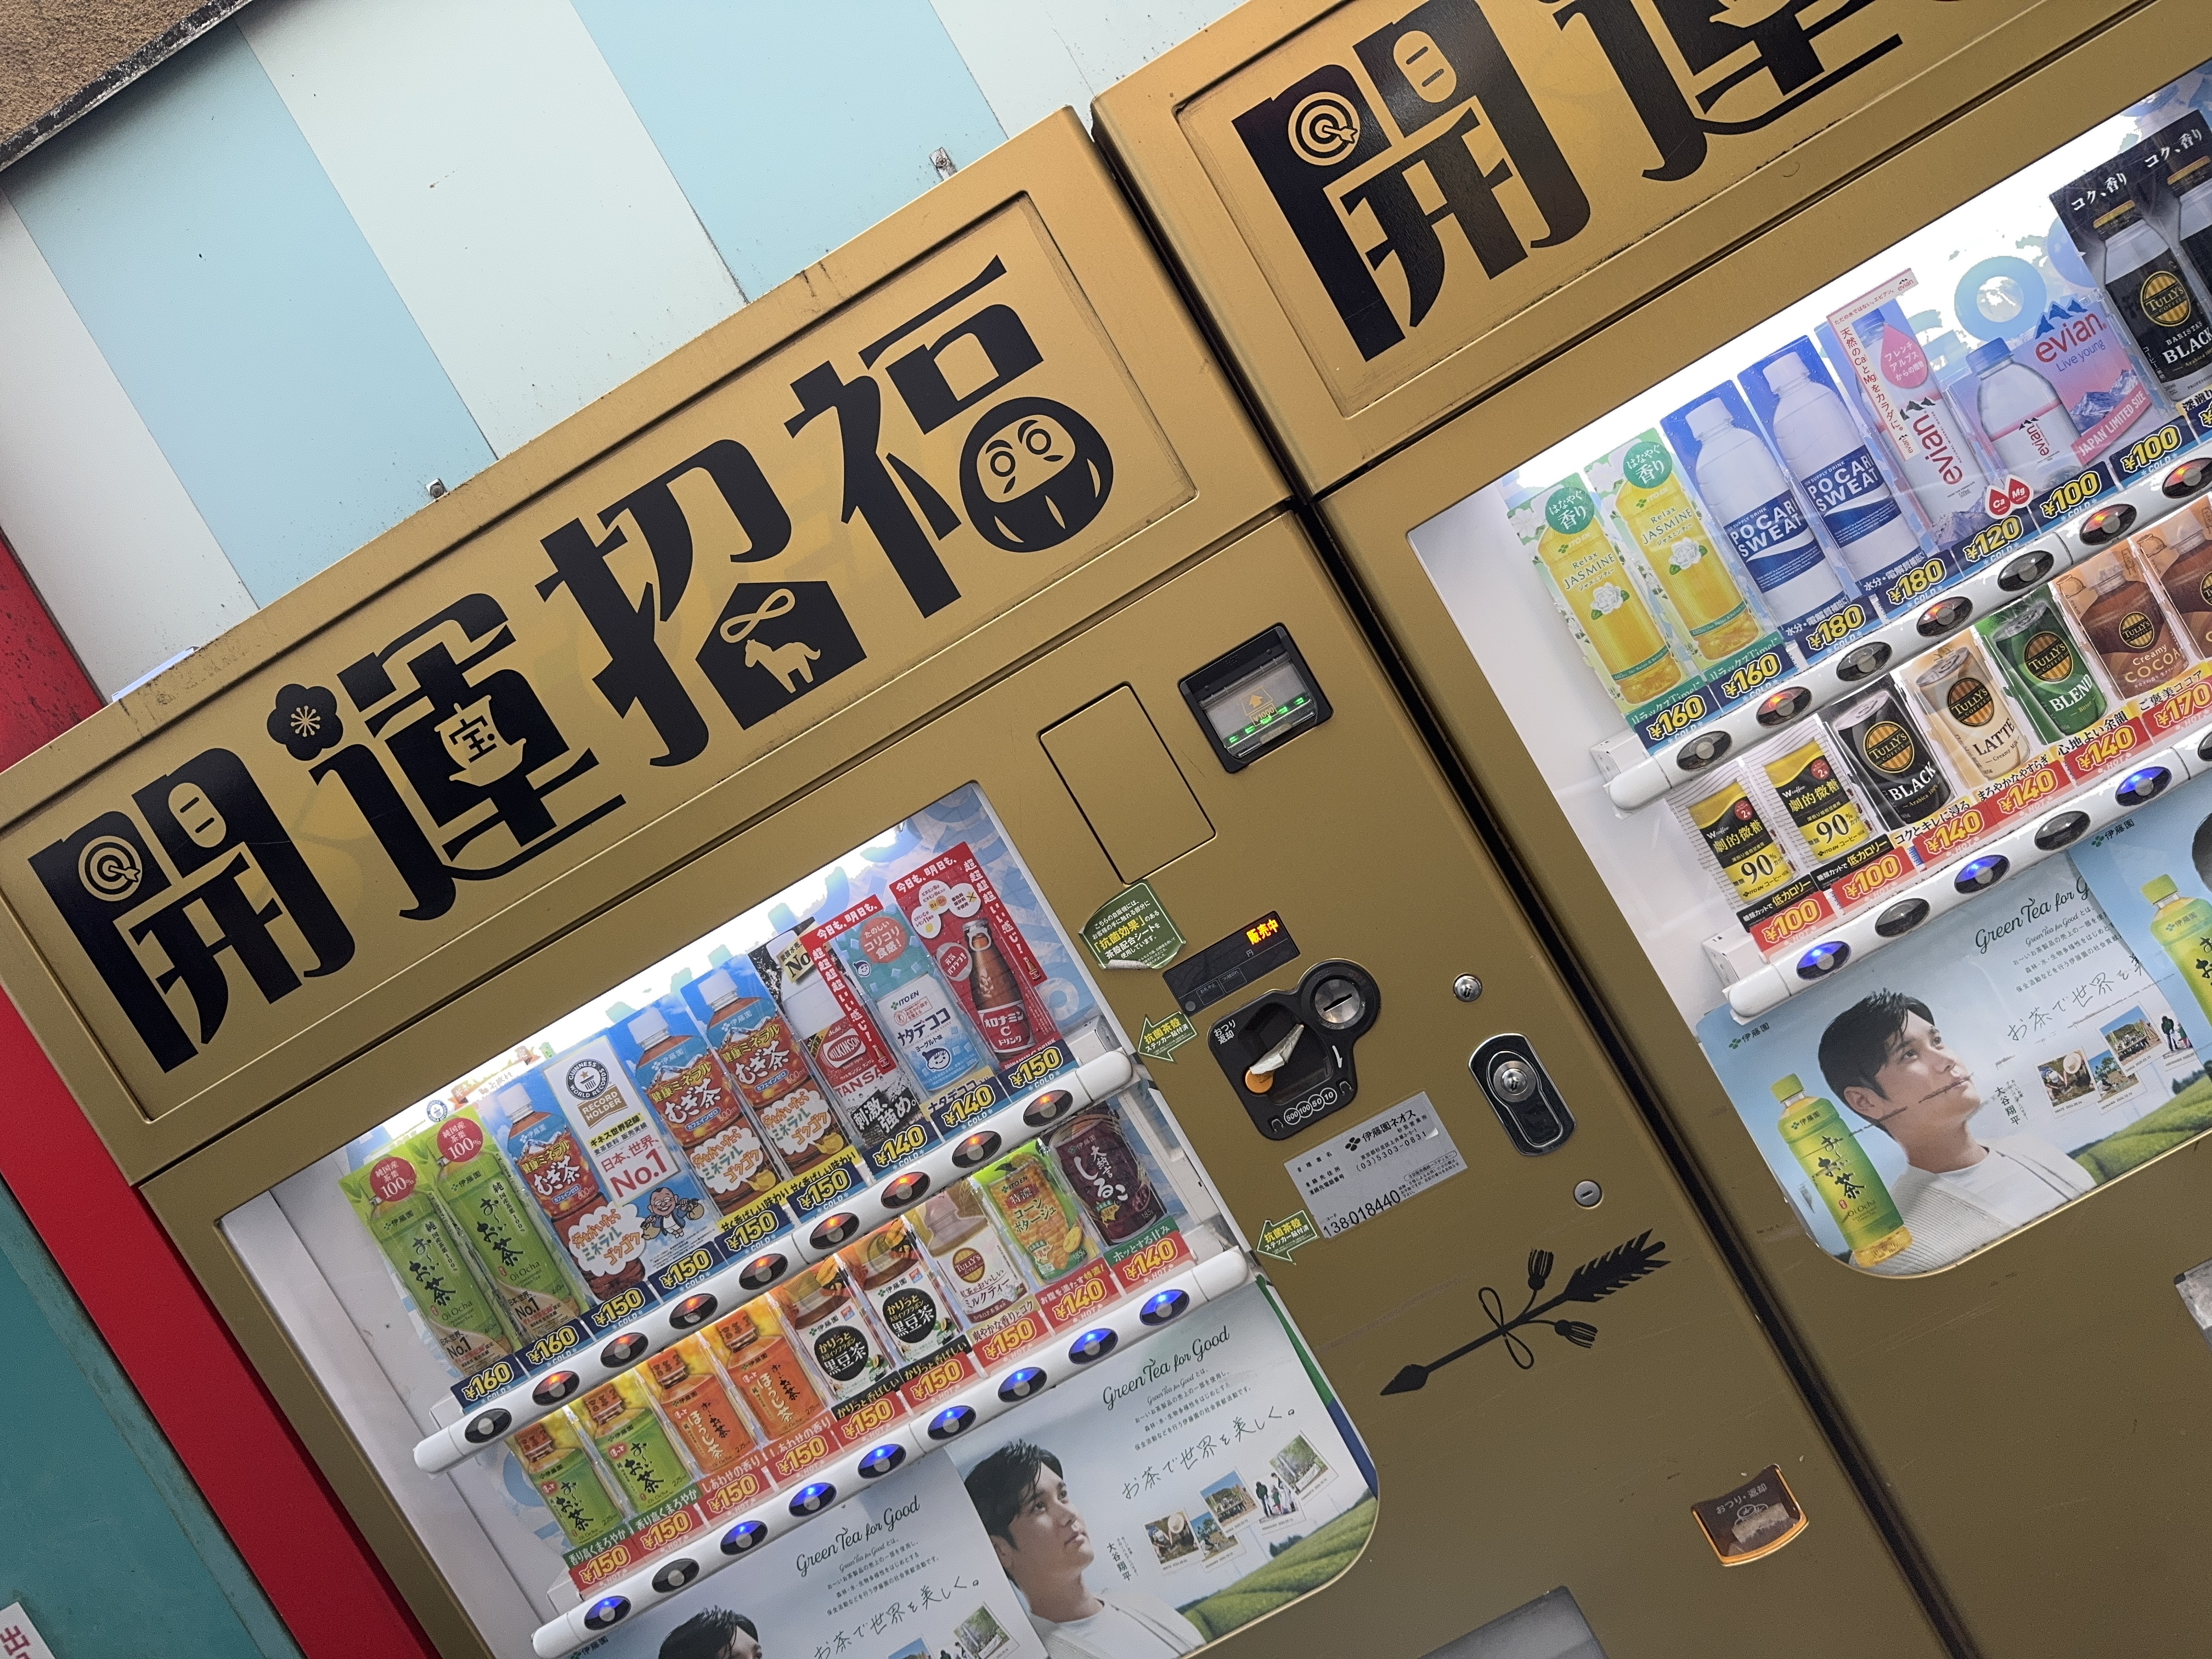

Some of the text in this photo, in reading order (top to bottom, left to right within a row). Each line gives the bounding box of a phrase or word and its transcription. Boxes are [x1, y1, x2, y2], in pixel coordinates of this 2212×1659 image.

[2145, 129, 2202, 168] コク、香り
[2072, 173, 2127, 211] コク、香り
[2035, 312, 2105, 363] evian
[2056, 338, 2106, 372] Live young
[2078, 389, 2147, 458] JAPAN LIMITED SIZE
[1626, 444, 1661, 469] はなやぐ
[1913, 415, 1963, 486] evian
[2121, 425, 2182, 472] ¥100
[1635, 460, 1665, 484] 香り
[1808, 453, 1874, 500] POCARI
[1815, 467, 1880, 512] SWEAT
[1548, 490, 1583, 516] はなやぐ
[2040, 471, 2101, 518] ¥100
[1557, 505, 1587, 530] 香り
[1641, 508, 1693, 545] JASMINE
[1650, 506, 1677, 524] Relax
[1730, 497, 1798, 545] POCARI
[1738, 513, 1802, 558] SWEAT
[1963, 516, 2022, 562] ¥120
[1564, 553, 1616, 590] JASMINE
[1572, 551, 1598, 569] Relax
[1887, 558, 1946, 605] ¥180
[1807, 604, 1865, 651] ¥180
[2123, 620, 2150, 639] TULLY'S
[2029, 643, 2066, 670] TULLY'S
[2124, 647, 2181, 682] COCOA
[2132, 644, 2167, 665] Creamy
[1722, 652, 1782, 698] ¥160
[2049, 674, 2092, 712] BLEND
[1647, 695, 1707, 741] ¥160
[1951, 688, 1988, 715] TULLY'S
[2154, 681, 2212, 727] ¥170
[1869, 732, 1907, 760] TULLY'S
[1973, 718, 2016, 756] LATTE
[2076, 726, 2137, 771] ¥140
[1888, 761, 1937, 802] BLACK
[1999, 769, 2058, 814] ¥140
[1925, 811, 1985, 855] ¥140
[2104, 819, 2135, 840] 伊藤園
[1843, 854, 1903, 900] ¥100
[864, 928, 900, 952] コリコリ
[1246, 919, 1279, 945] 販売中
[1763, 898, 1821, 943] ¥100
[1975, 891, 2074, 954] Green Tea for
[899, 990, 919, 1006] ITO EN
[898, 1007, 951, 1047] ナタデココ
[1214, 1019, 1236, 1037] おつり
[1217, 1030, 1234, 1045] 返却
[736, 1040, 790, 1084] むぎ茶
[829, 1036, 860, 1060] WILKINSON
[1009, 1047, 1063, 1087] ¥150
[582, 1091, 618, 1114] RECORD
[585, 1098, 622, 1121] HOLDER
[665, 1078, 722, 1124] むぎ茶
[943, 1085, 995, 1127] ¥140
[1286, 1091, 1334, 1121] 500 100 50 10
[1362, 1109, 1416, 1142] 伊藤園ネオス
[874, 1125, 927, 1167] ¥140
[534, 1155, 580, 1195] むぎ茶
[610, 1148, 668, 1198] No.1
[798, 1169, 851, 1210] ¥150
[726, 1210, 778, 1251] ¥150
[659, 1250, 712, 1289] ¥150
[1123, 1237, 1178, 1281] ¥140
[593, 1289, 645, 1326] ¥150
[1054, 1278, 1107, 1321] ¥140
[891, 1305, 934, 1338] 黒豆茶
[984, 1317, 1037, 1359] ¥150
[527, 1327, 578, 1364] ¥160
[824, 1341, 867, 1376] 黒豆茶
[463, 1362, 512, 1400] ¥160
[911, 1359, 963, 1400] ¥150
[1103, 1325, 1229, 1410] Green Tea for Good
[842, 1399, 895, 1439] ¥150
[776, 1436, 829, 1476] ¥150
[709, 1474, 760, 1513] ¥150
[641, 1510, 692, 1551] ¥150
[796, 1495, 921, 1577] Green Tea for Good
[580, 1544, 630, 1584] ¥150
[0, 1626, 31, 1659] 出
